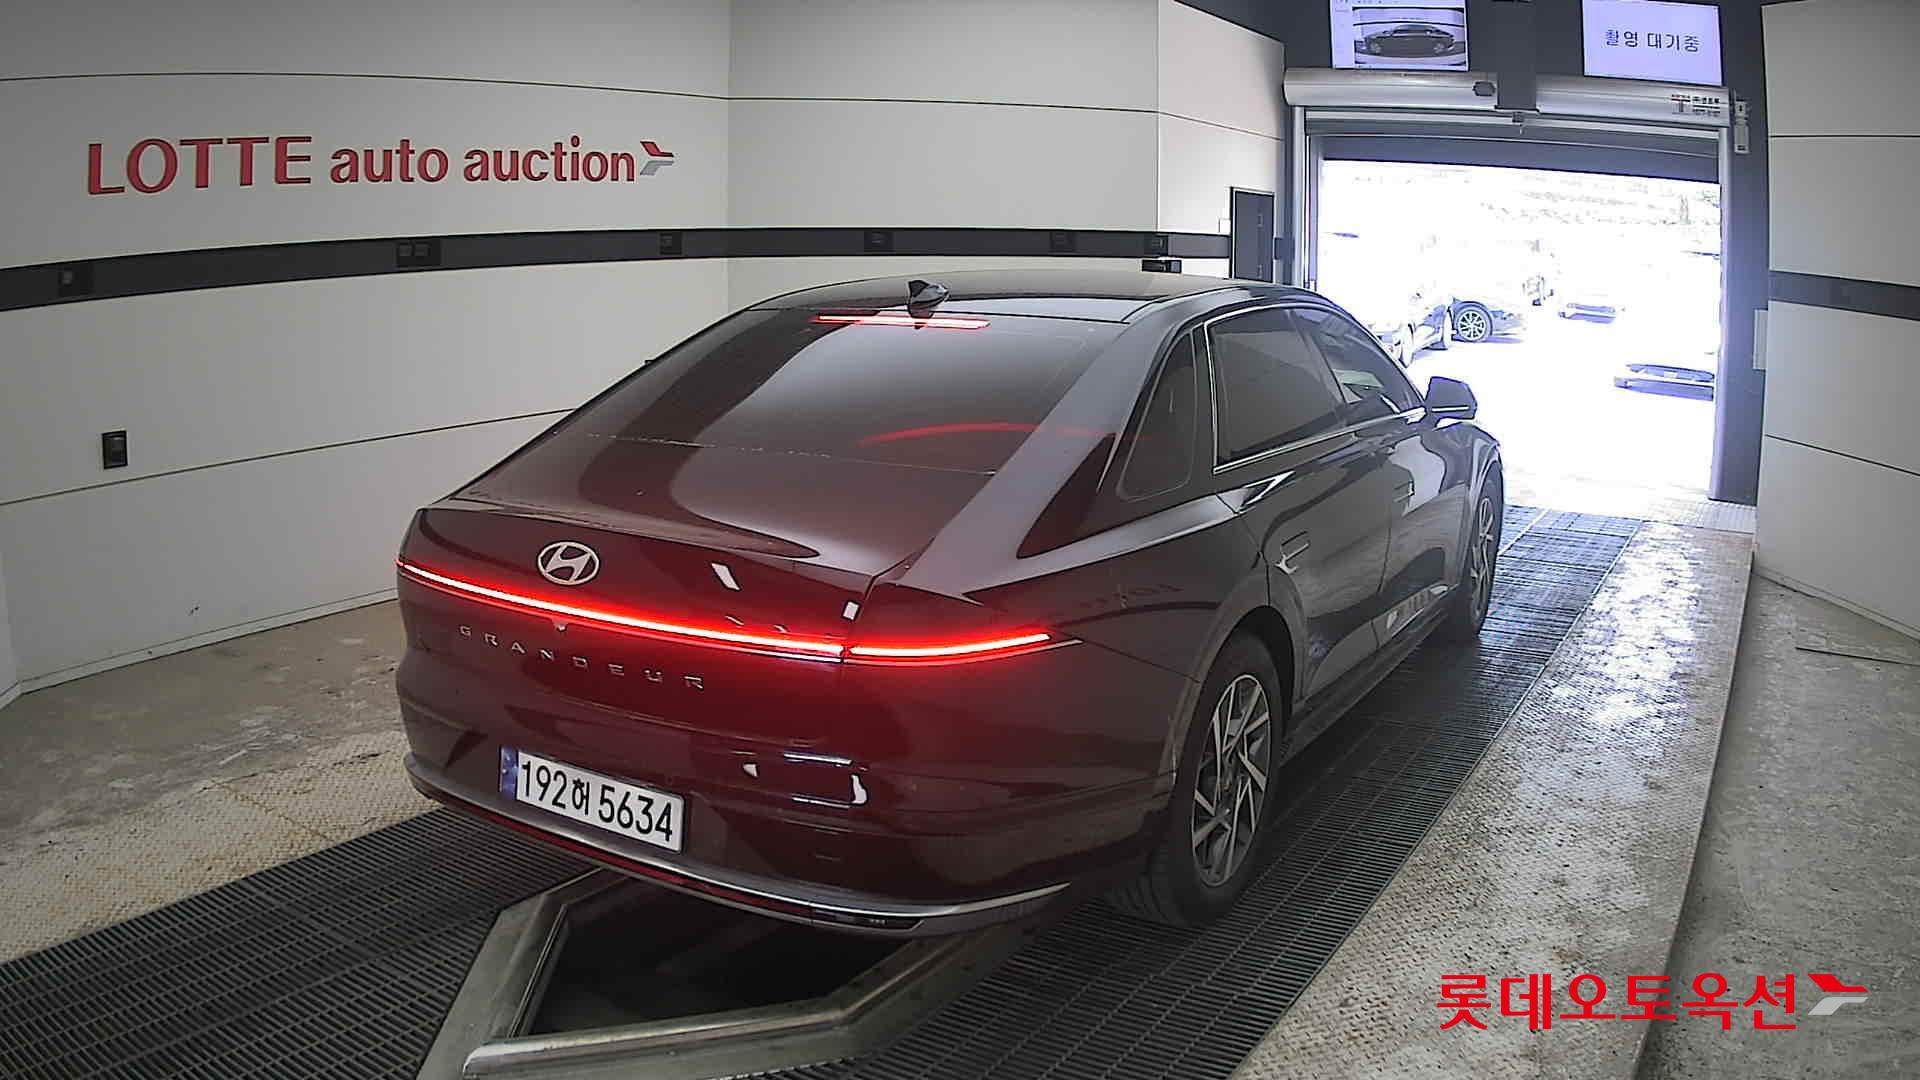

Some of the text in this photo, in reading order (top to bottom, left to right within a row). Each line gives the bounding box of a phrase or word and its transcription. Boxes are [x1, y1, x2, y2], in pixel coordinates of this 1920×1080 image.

[1647, 32, 1699, 52] 대기중
[88, 136, 636, 195] LOTTE auto auction
[459, 625, 704, 690] GRANDEUR
[521, 760, 673, 842] 192허 5634
